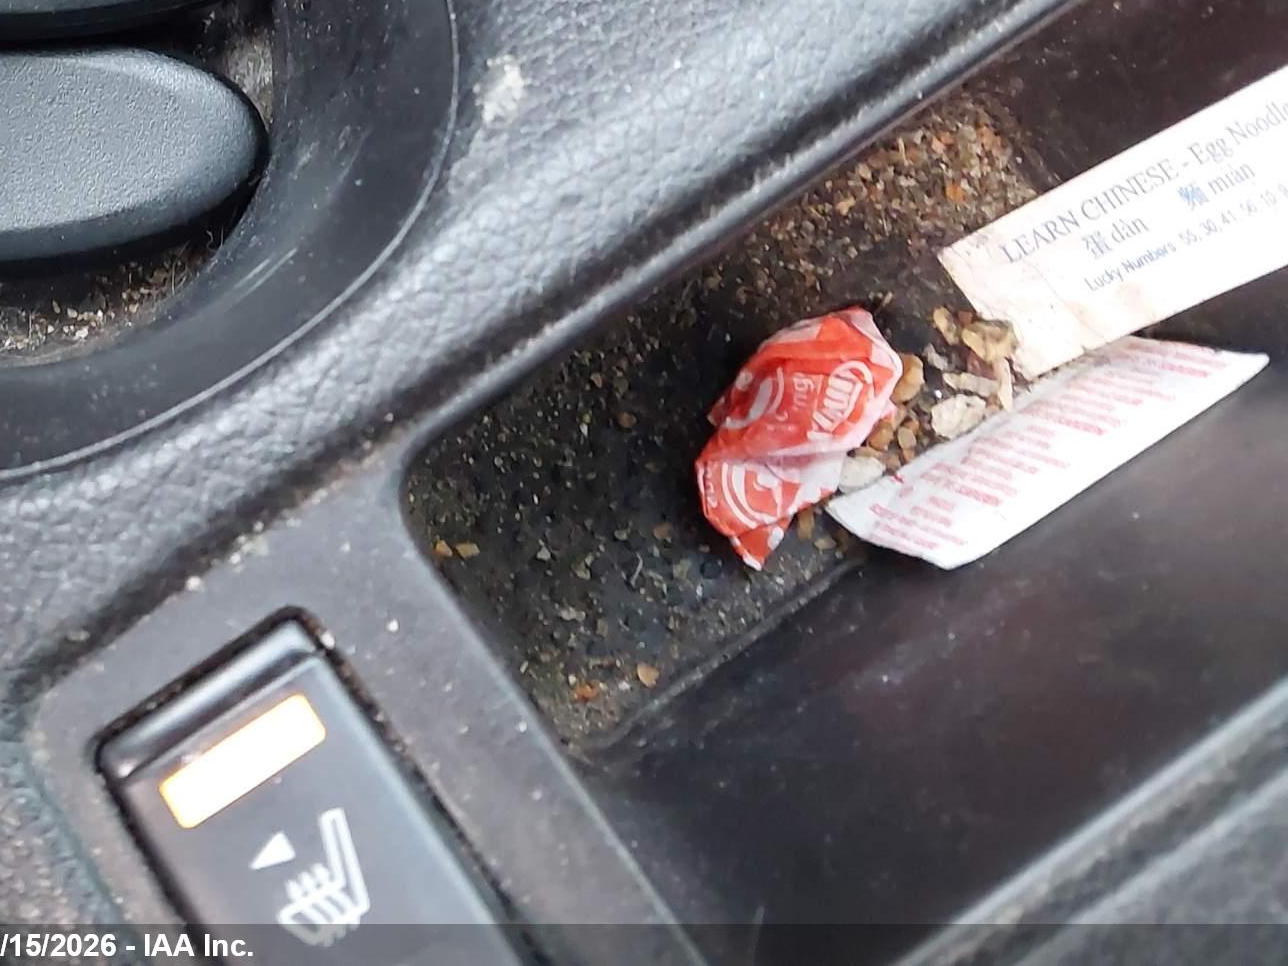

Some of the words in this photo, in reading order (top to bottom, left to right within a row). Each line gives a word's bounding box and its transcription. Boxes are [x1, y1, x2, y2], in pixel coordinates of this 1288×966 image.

[1000, 210, 1081, 264] LEARN
[1080, 158, 1179, 221] CHINESE
[1188, 133, 1233, 165] Egg
[1083, 265, 1124, 292] Lucky
